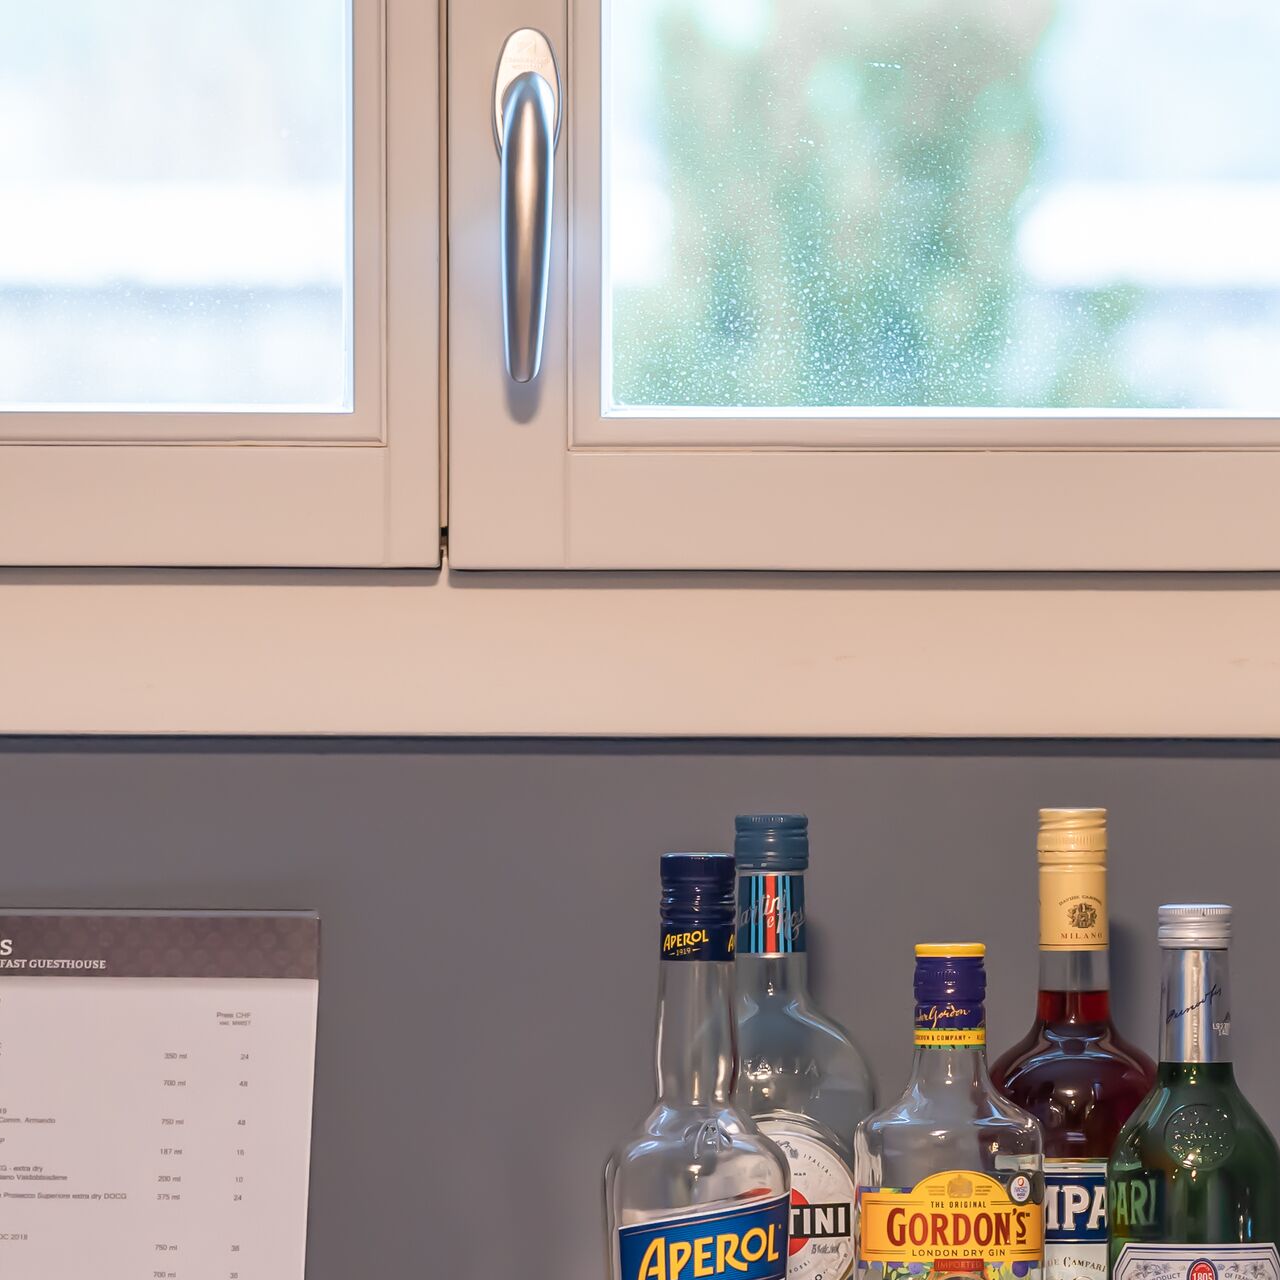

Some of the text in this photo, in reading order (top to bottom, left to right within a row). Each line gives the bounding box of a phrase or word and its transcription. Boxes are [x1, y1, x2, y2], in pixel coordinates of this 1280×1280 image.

[663, 929, 709, 952] APEROL
[1060, 932, 1103, 940] MILANO
[29, 959, 107, 969] GUESTHOUSE
[930, 1200, 987, 1209] THE ORIGINAL
[789, 1206, 846, 1235] TINI
[886, 1207, 1027, 1247] GORDON'S
[911, 1249, 1006, 1257] LONDON DRY GIN
